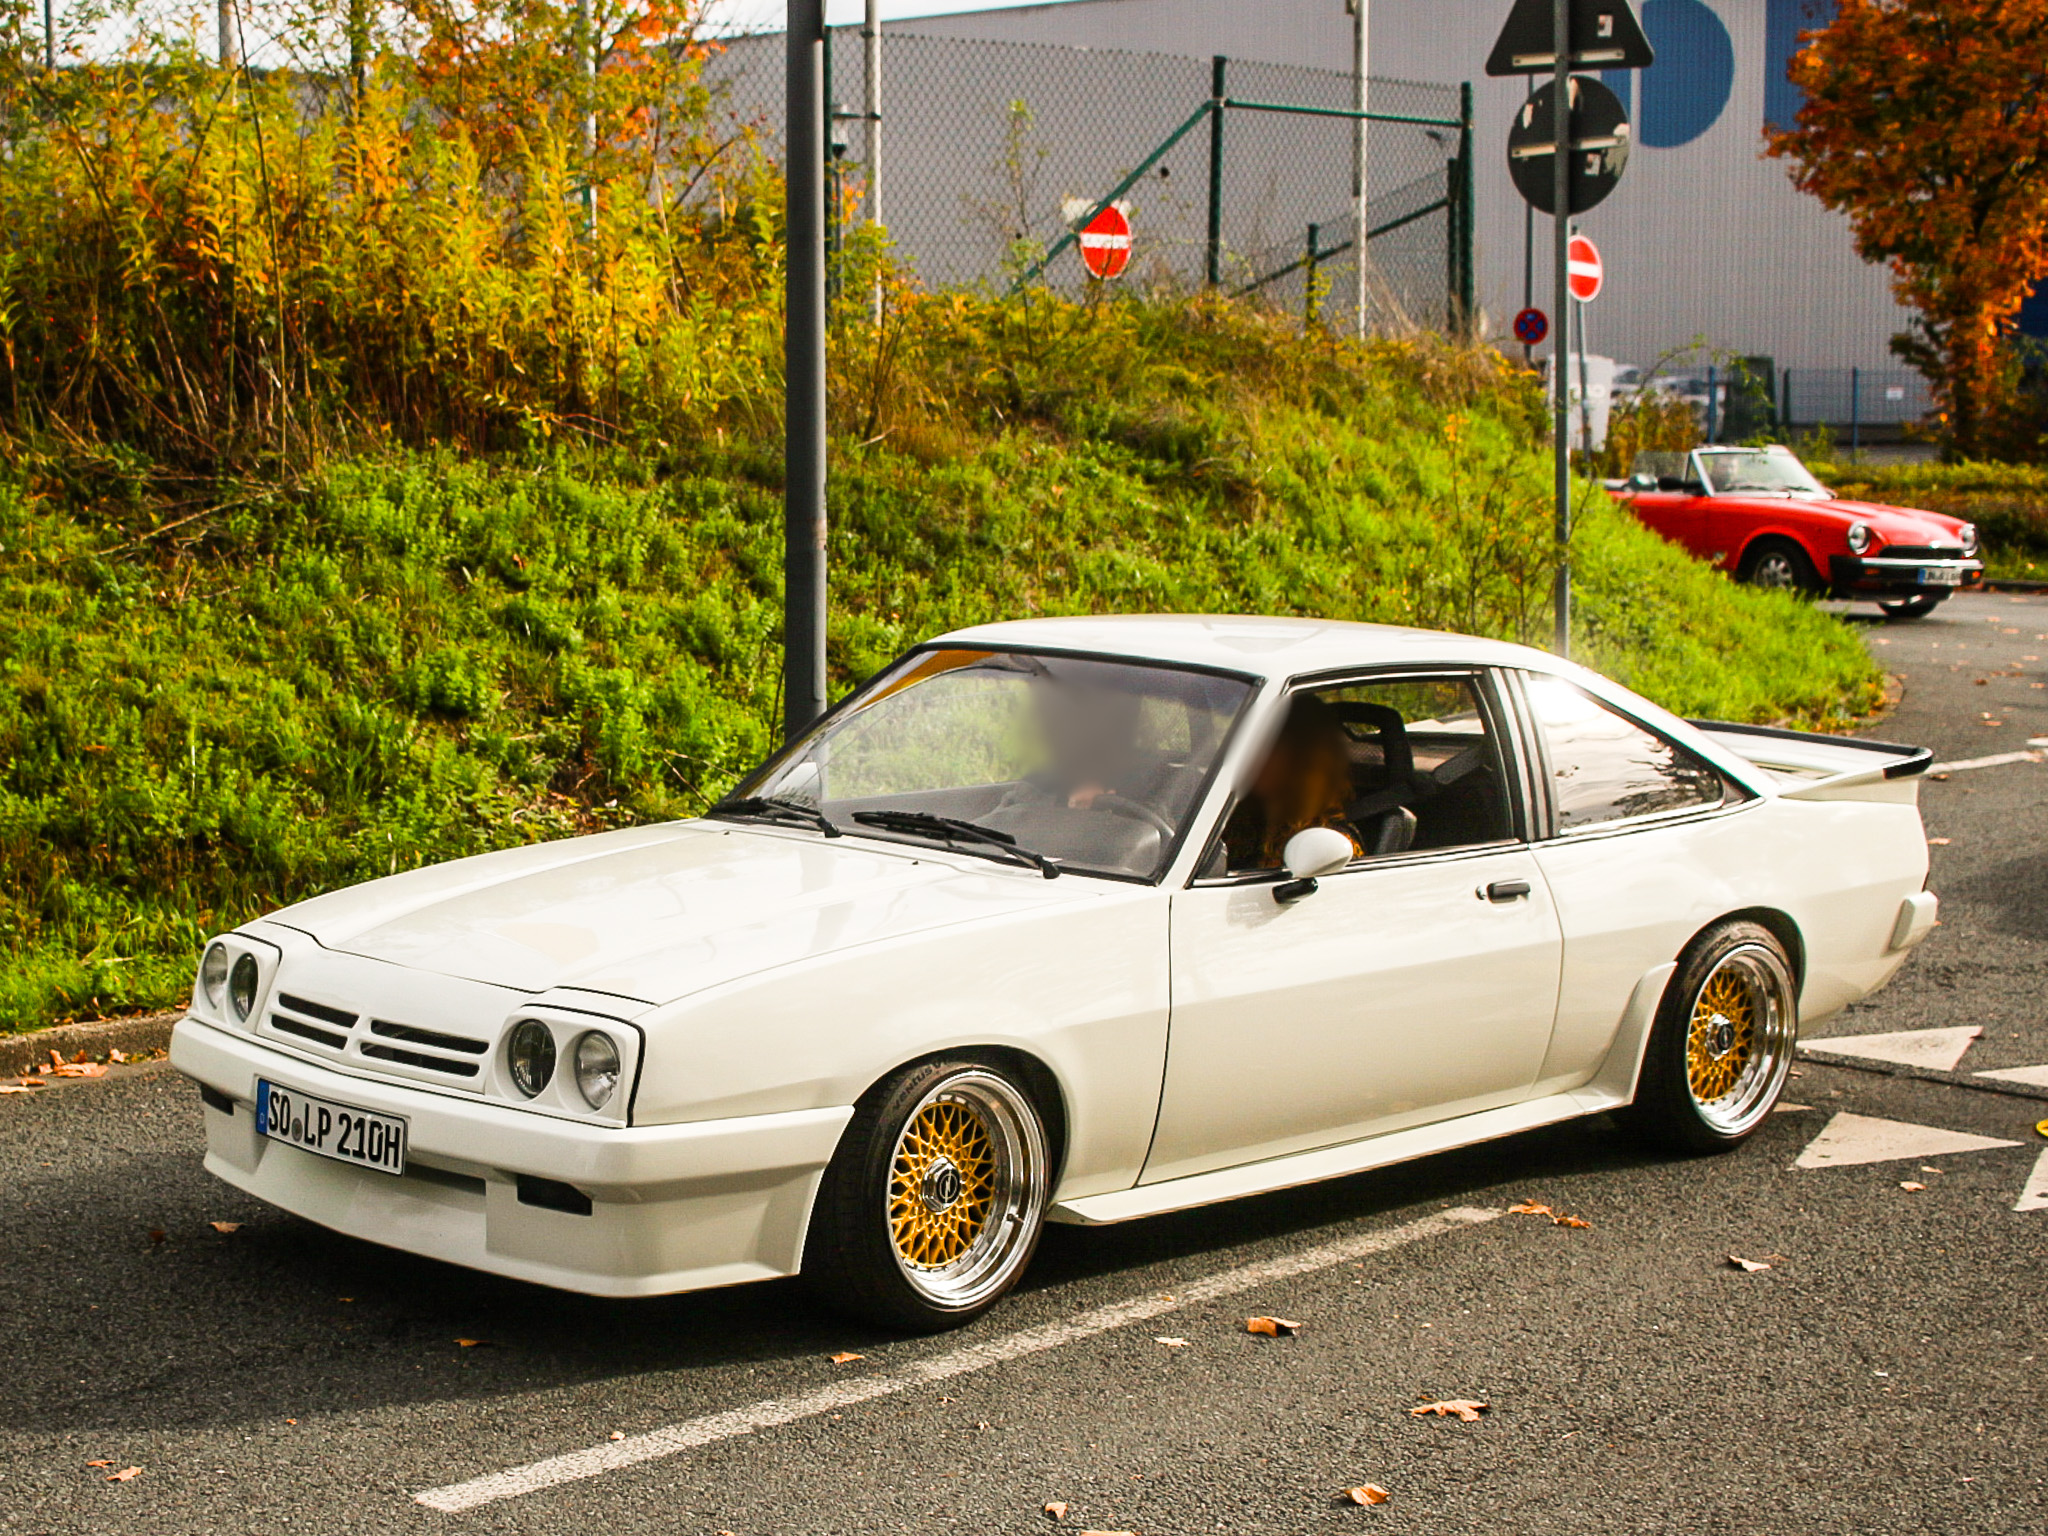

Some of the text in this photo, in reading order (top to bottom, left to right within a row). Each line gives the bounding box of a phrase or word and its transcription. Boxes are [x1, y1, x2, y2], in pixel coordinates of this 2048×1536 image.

[269, 1091, 401, 1168] SO LP 210H
